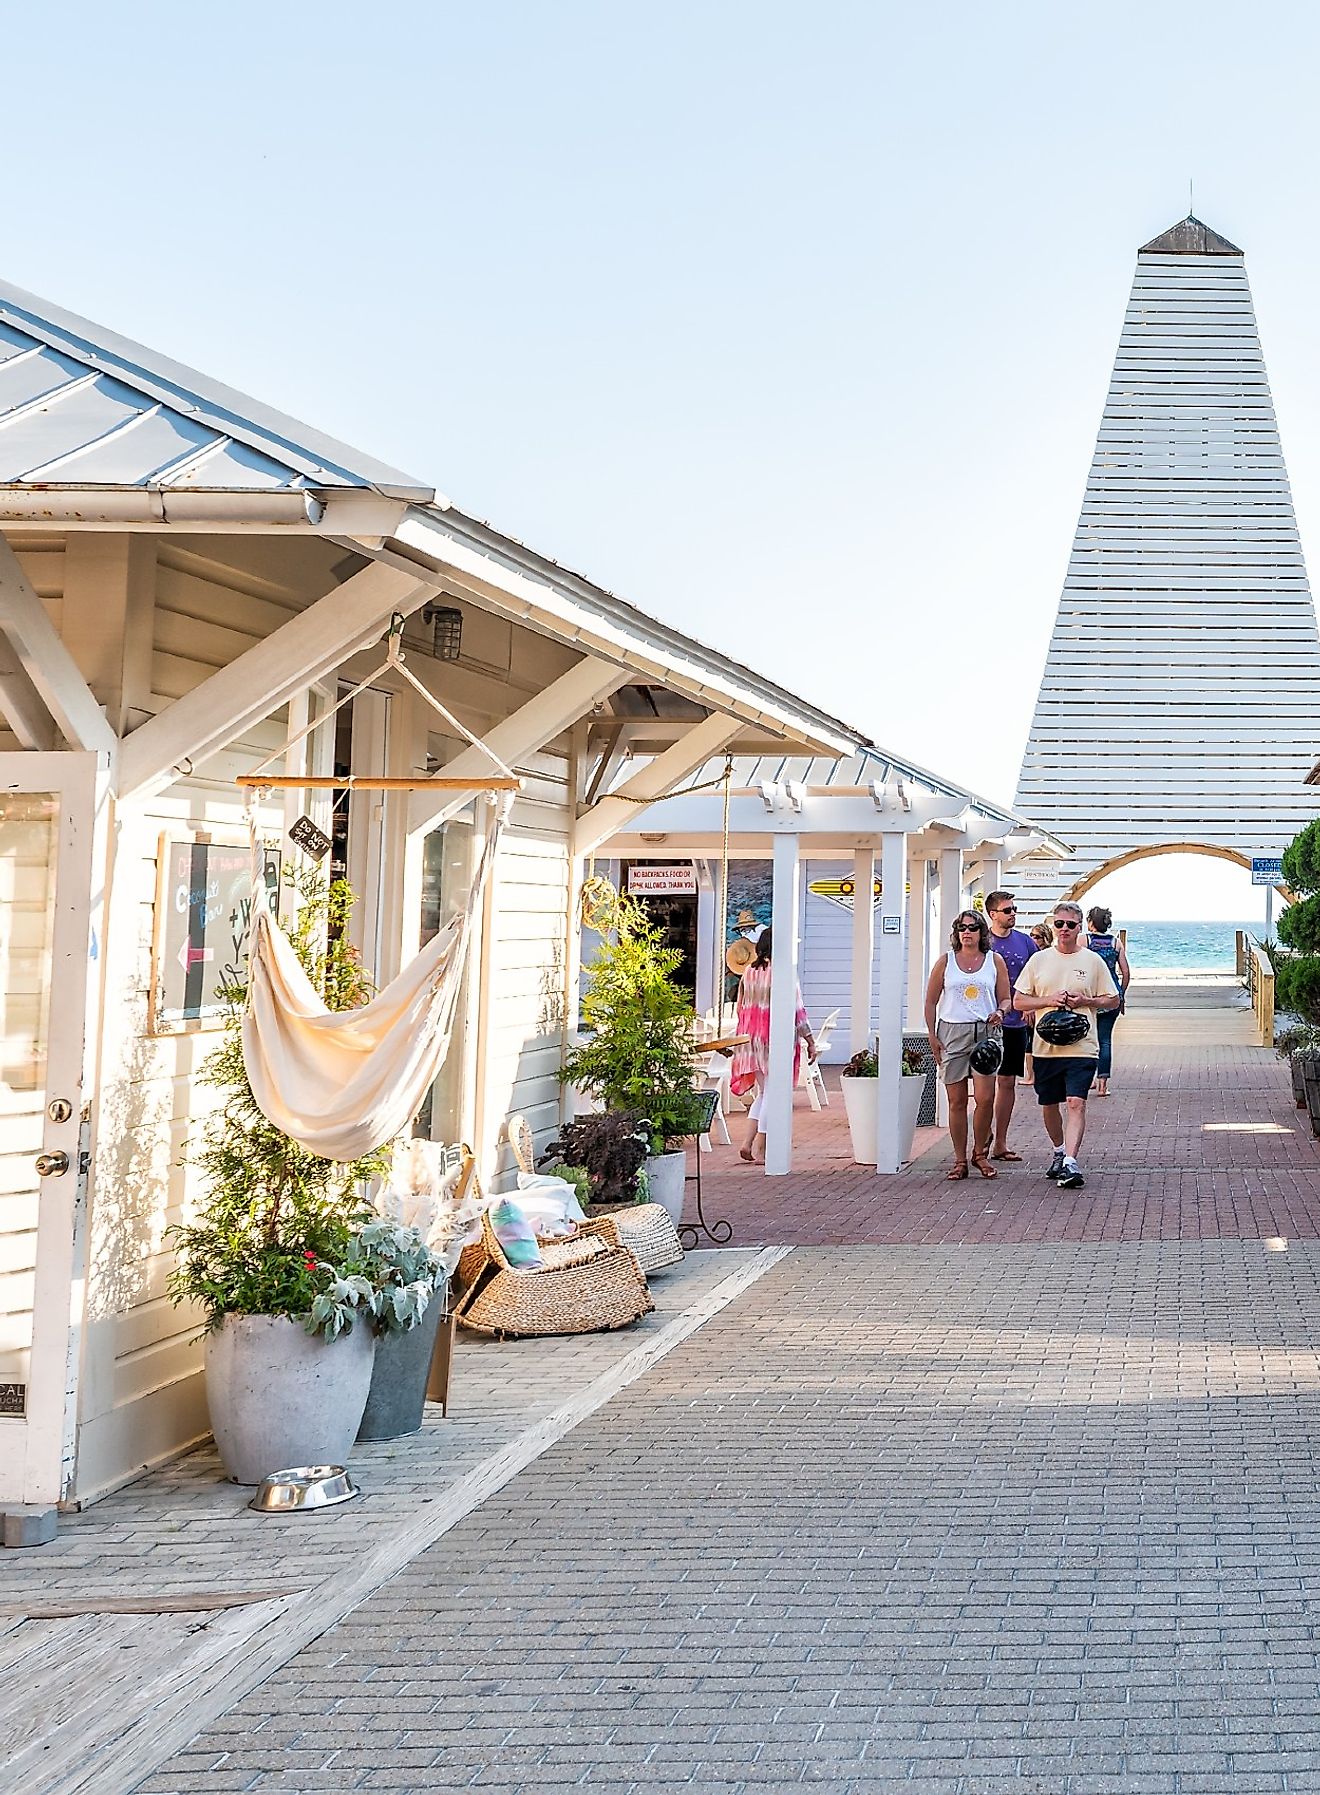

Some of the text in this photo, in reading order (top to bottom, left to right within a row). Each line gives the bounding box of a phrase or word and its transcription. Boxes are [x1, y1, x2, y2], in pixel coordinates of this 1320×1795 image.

[299, 820, 330, 850] DO NOT
[307, 839, 320, 851] ON
